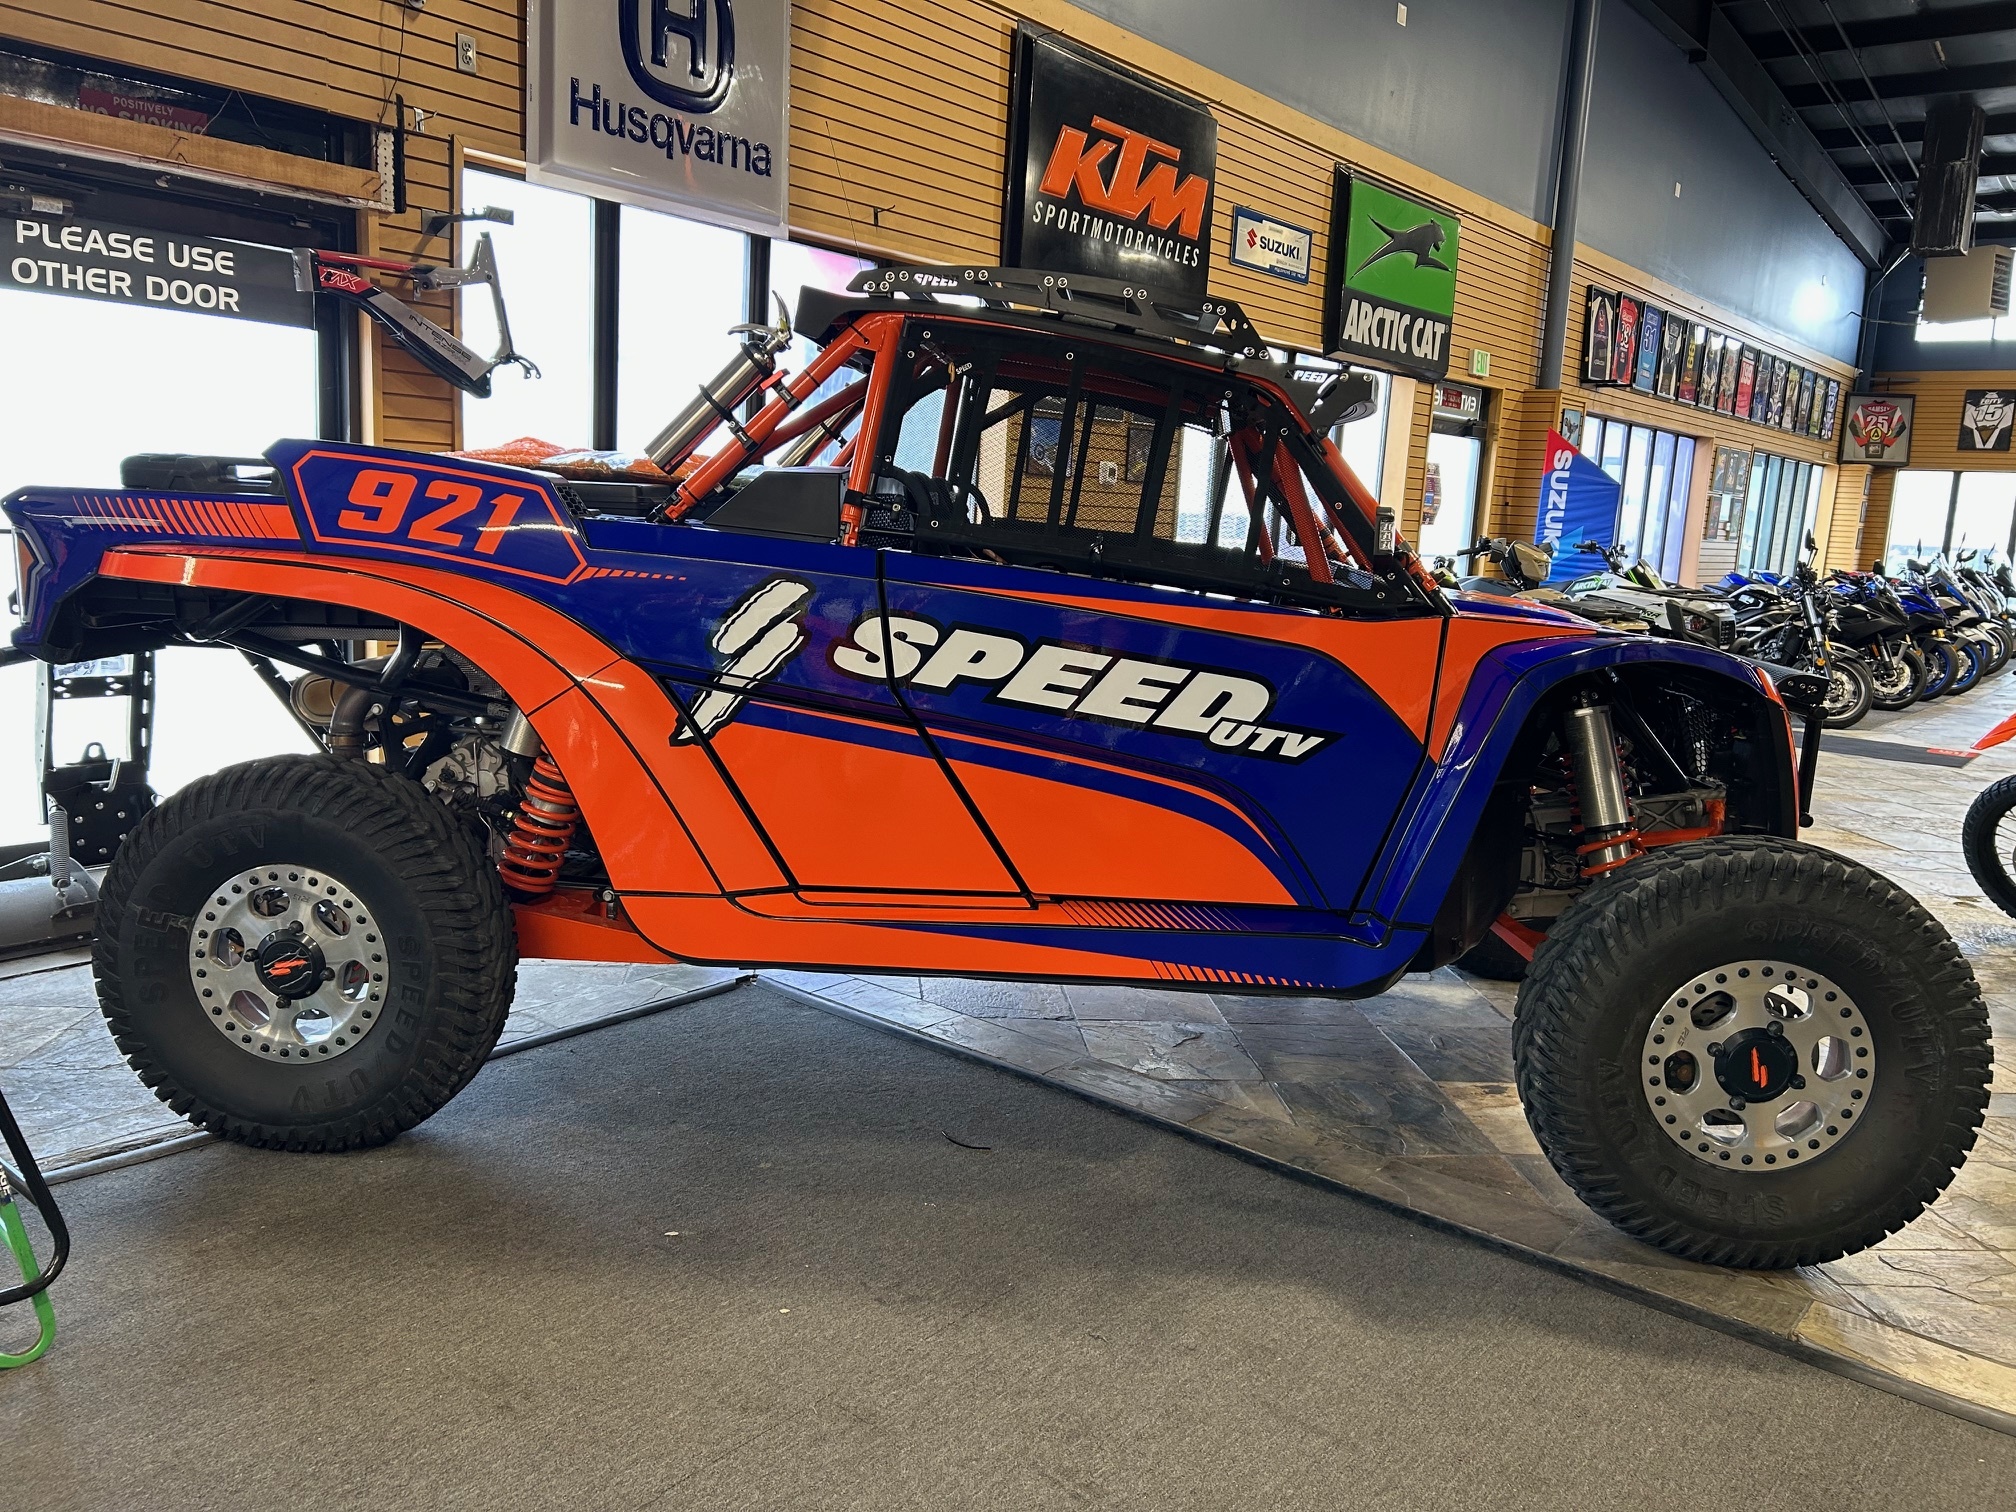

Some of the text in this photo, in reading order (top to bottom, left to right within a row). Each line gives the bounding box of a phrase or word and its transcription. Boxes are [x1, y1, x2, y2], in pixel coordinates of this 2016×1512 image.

[113, 96, 174, 116] POSITIVELY
[570, 77, 772, 177] Husqvarna
[1039, 115, 1209, 240] KTM
[16, 219, 235, 276] PLEASE USE
[1032, 201, 1200, 267] SPORTMOTORCYCLES
[1259, 236, 1300, 260] SUZUKI
[11, 257, 240, 312] OTHER DOOR
[913, 273, 959, 287] SPEED
[409, 314, 473, 361] INTENSE
[1342, 298, 1446, 361] ARCTIC CAT
[955, 362, 973, 375] SPEED
[1476, 351, 1488, 374] EXIT
[1865, 415, 1889, 434] 25
[1975, 404, 2004, 422] 15
[338, 469, 525, 554] 921
[1542, 449, 1573, 557] SUZUK
[833, 616, 1270, 734] SPEED
[1207, 720, 1325, 758] UTV
